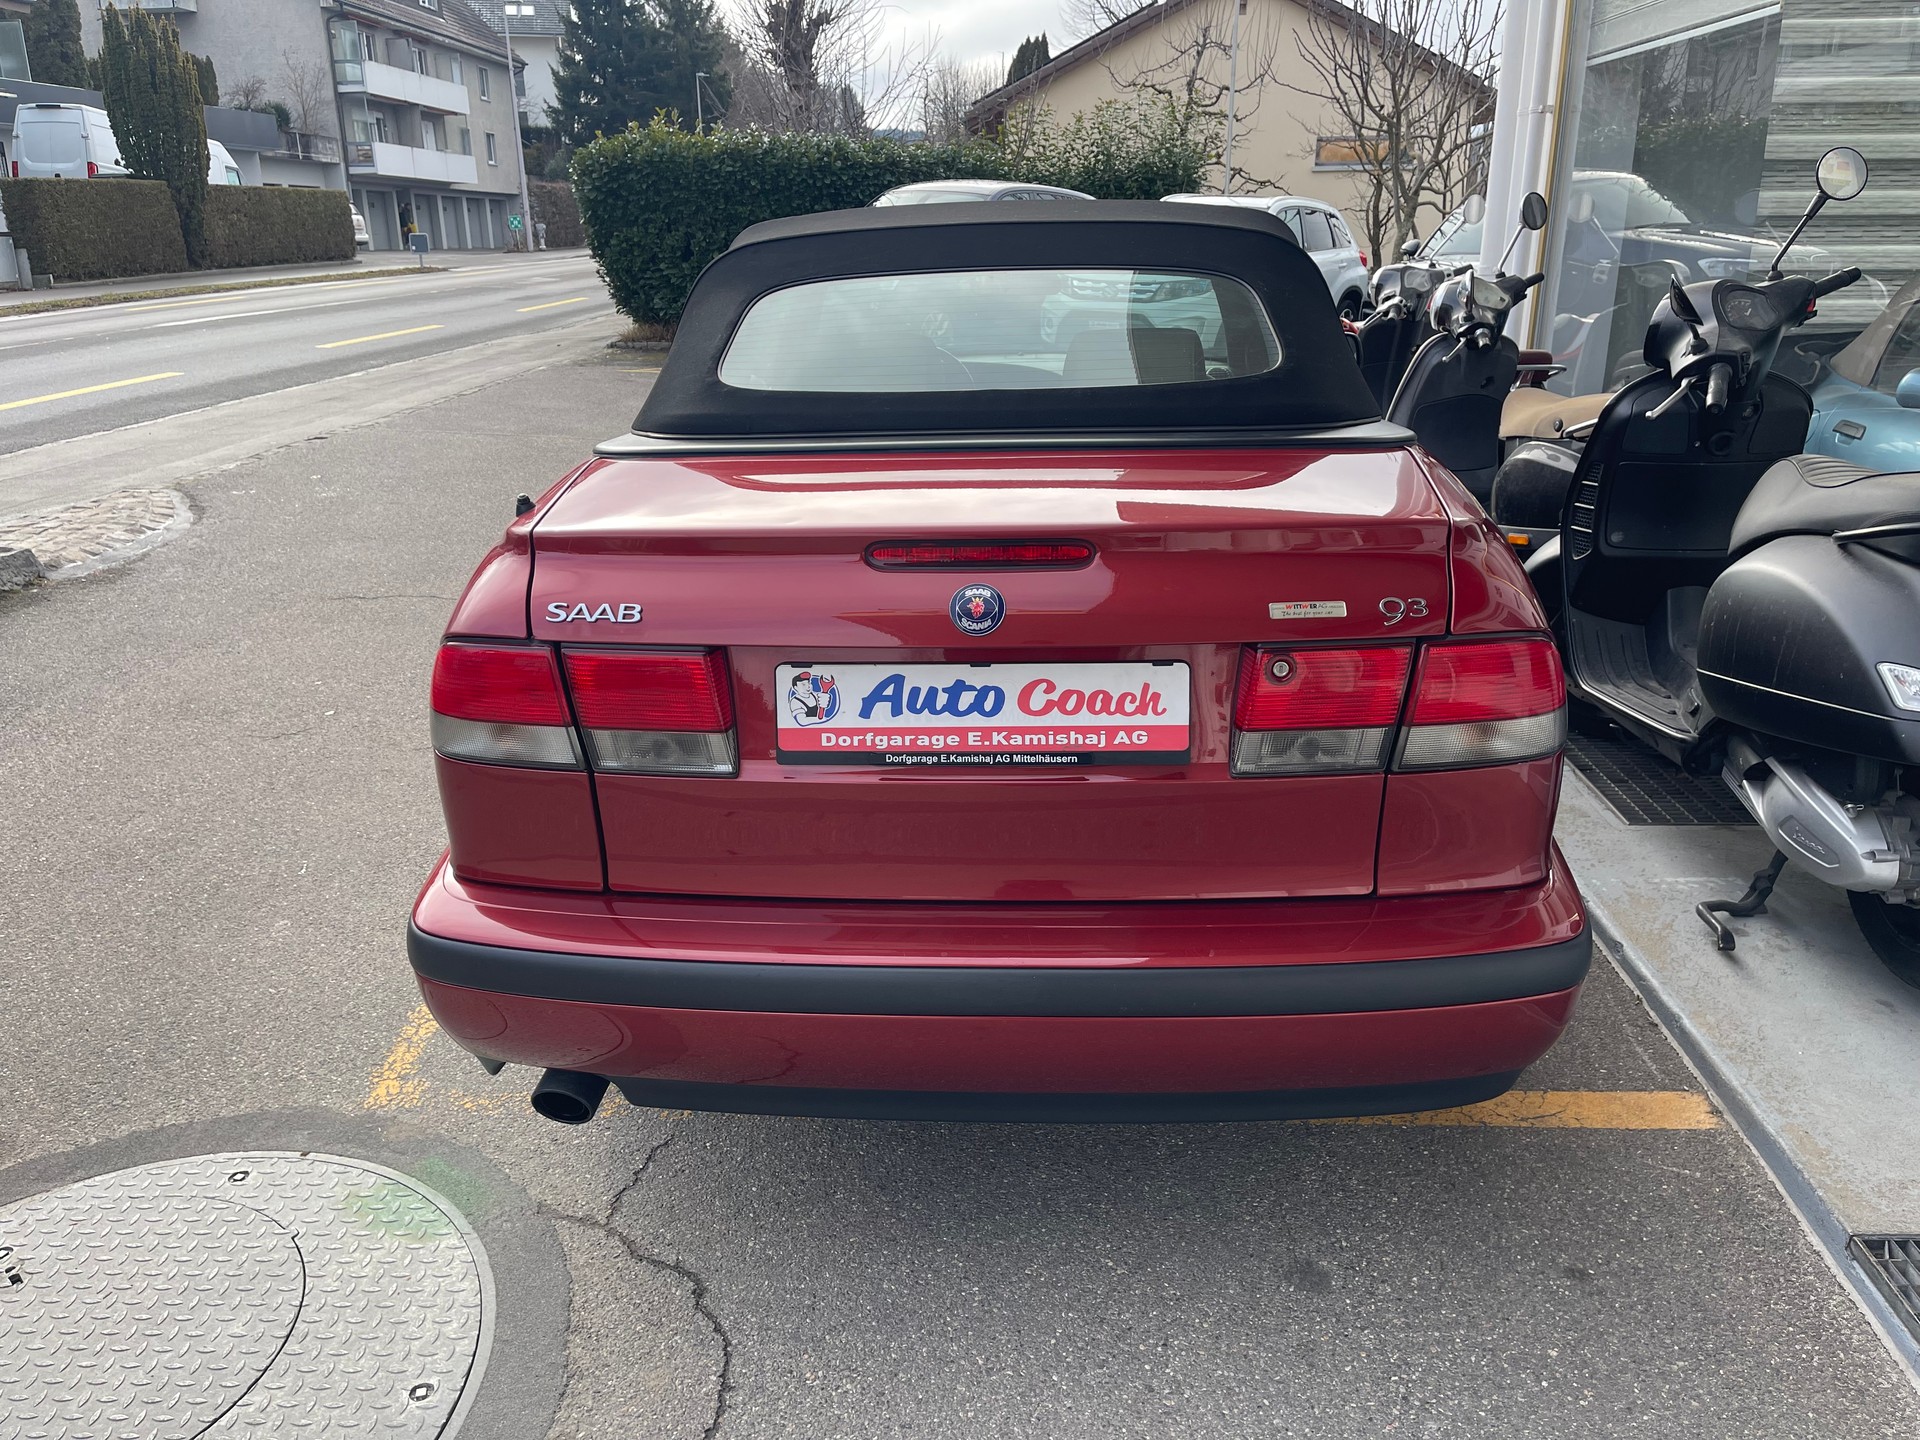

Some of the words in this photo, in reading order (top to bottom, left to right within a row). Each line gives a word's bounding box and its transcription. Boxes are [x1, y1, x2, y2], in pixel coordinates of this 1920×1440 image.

[964, 588, 992, 597] SAAB
[545, 602, 643, 623] SAAB
[960, 617, 992, 631] SCANIA
[858, 673, 1006, 719] Auto
[1016, 678, 1167, 717] Coach
[820, 732, 960, 749] Dorfgarage
[967, 730, 1106, 748] E.Kamishaj
[1112, 730, 1149, 745] AG
[885, 754, 938, 765] Dorfgarage
[940, 754, 993, 765] E.Kamishaj
[995, 754, 1010, 763] AG
[1012, 753, 1078, 763] Mittelhäusern
